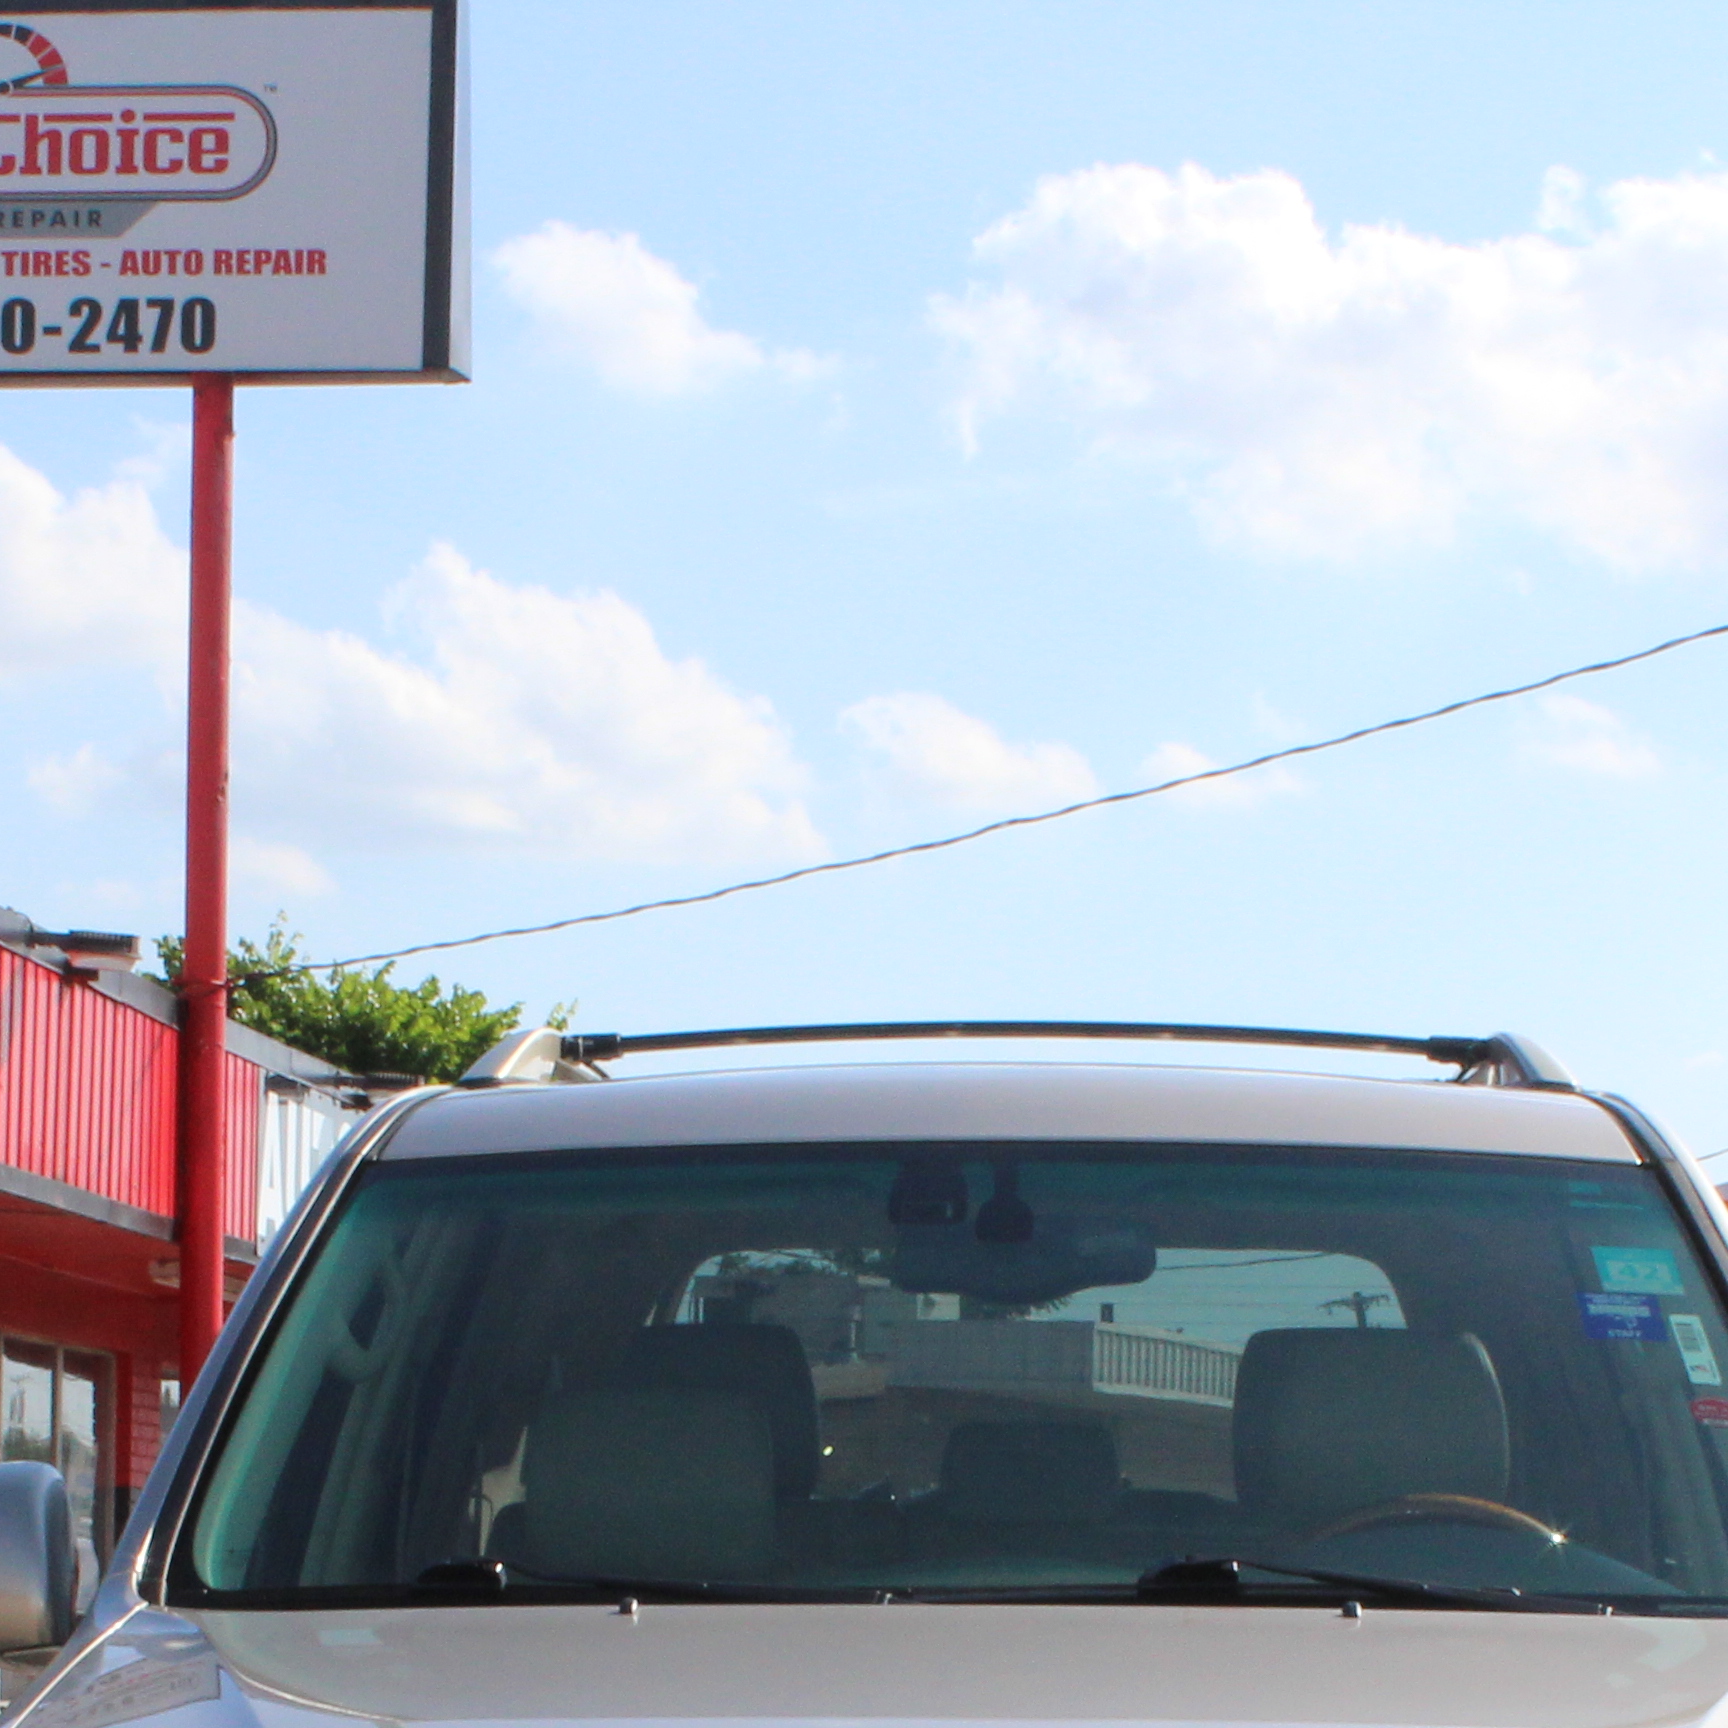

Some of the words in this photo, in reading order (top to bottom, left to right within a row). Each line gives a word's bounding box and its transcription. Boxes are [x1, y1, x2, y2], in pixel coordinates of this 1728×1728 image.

[1, 250, 91, 277] TIRES
[119, 249, 204, 277] AUTO
[213, 248, 327, 276] REPAIR
